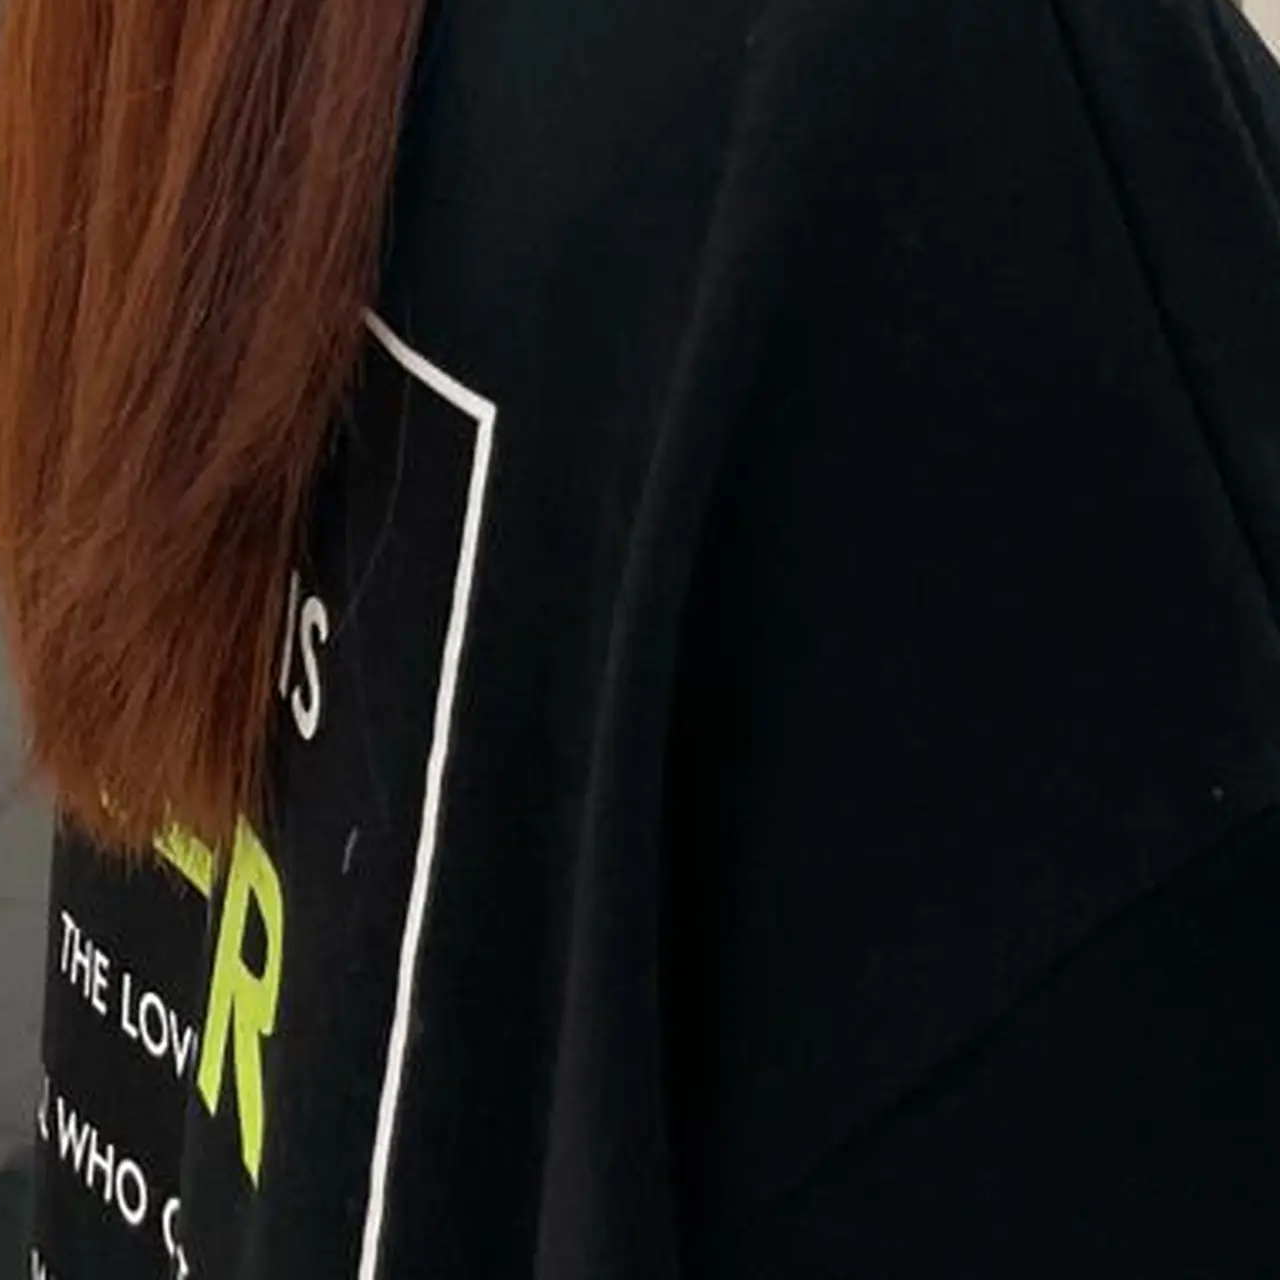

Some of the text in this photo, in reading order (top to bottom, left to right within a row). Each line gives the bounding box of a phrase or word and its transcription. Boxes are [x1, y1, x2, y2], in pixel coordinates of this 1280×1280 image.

[60, 910, 200, 1079] THE LOV
[57, 1095, 148, 1227] WHO
